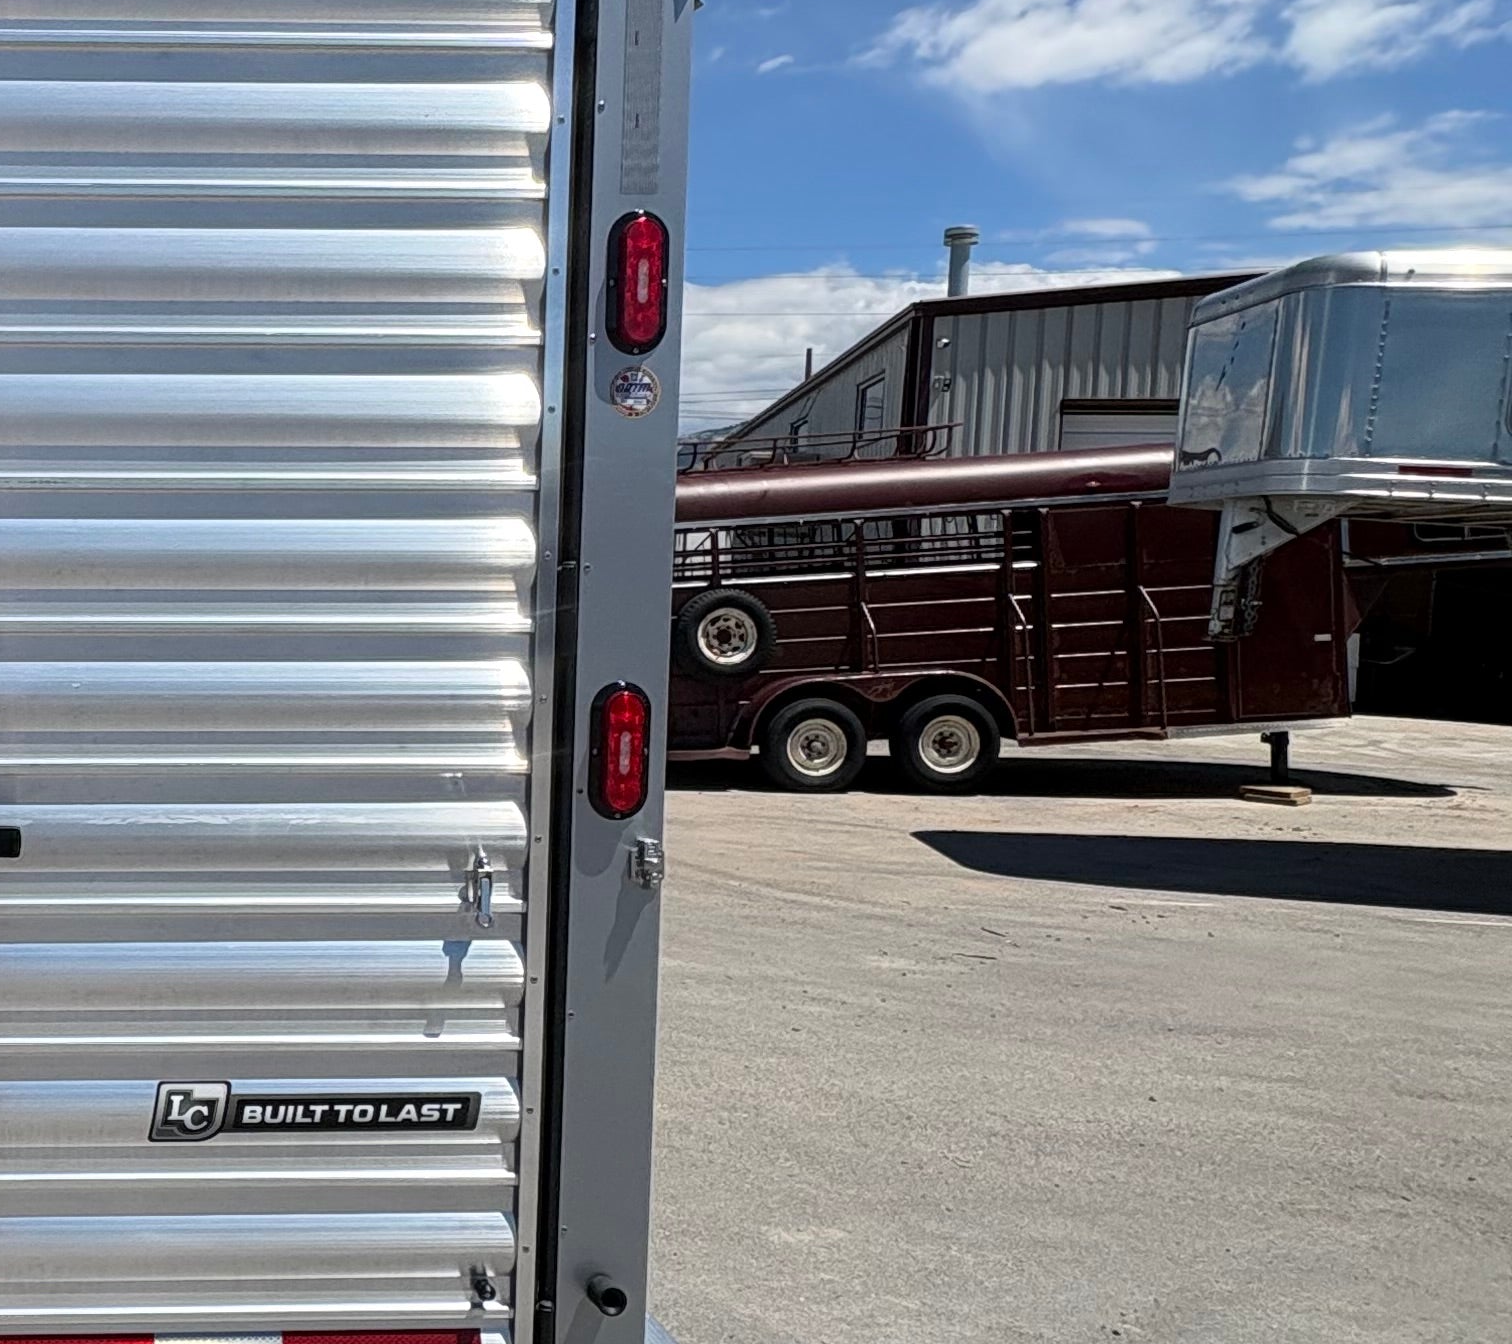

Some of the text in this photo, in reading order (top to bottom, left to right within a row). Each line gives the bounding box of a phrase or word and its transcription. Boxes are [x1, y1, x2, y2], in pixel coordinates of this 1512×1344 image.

[167, 1095, 209, 1130] LC
[242, 1103, 462, 1124] BUILT TO LAST
